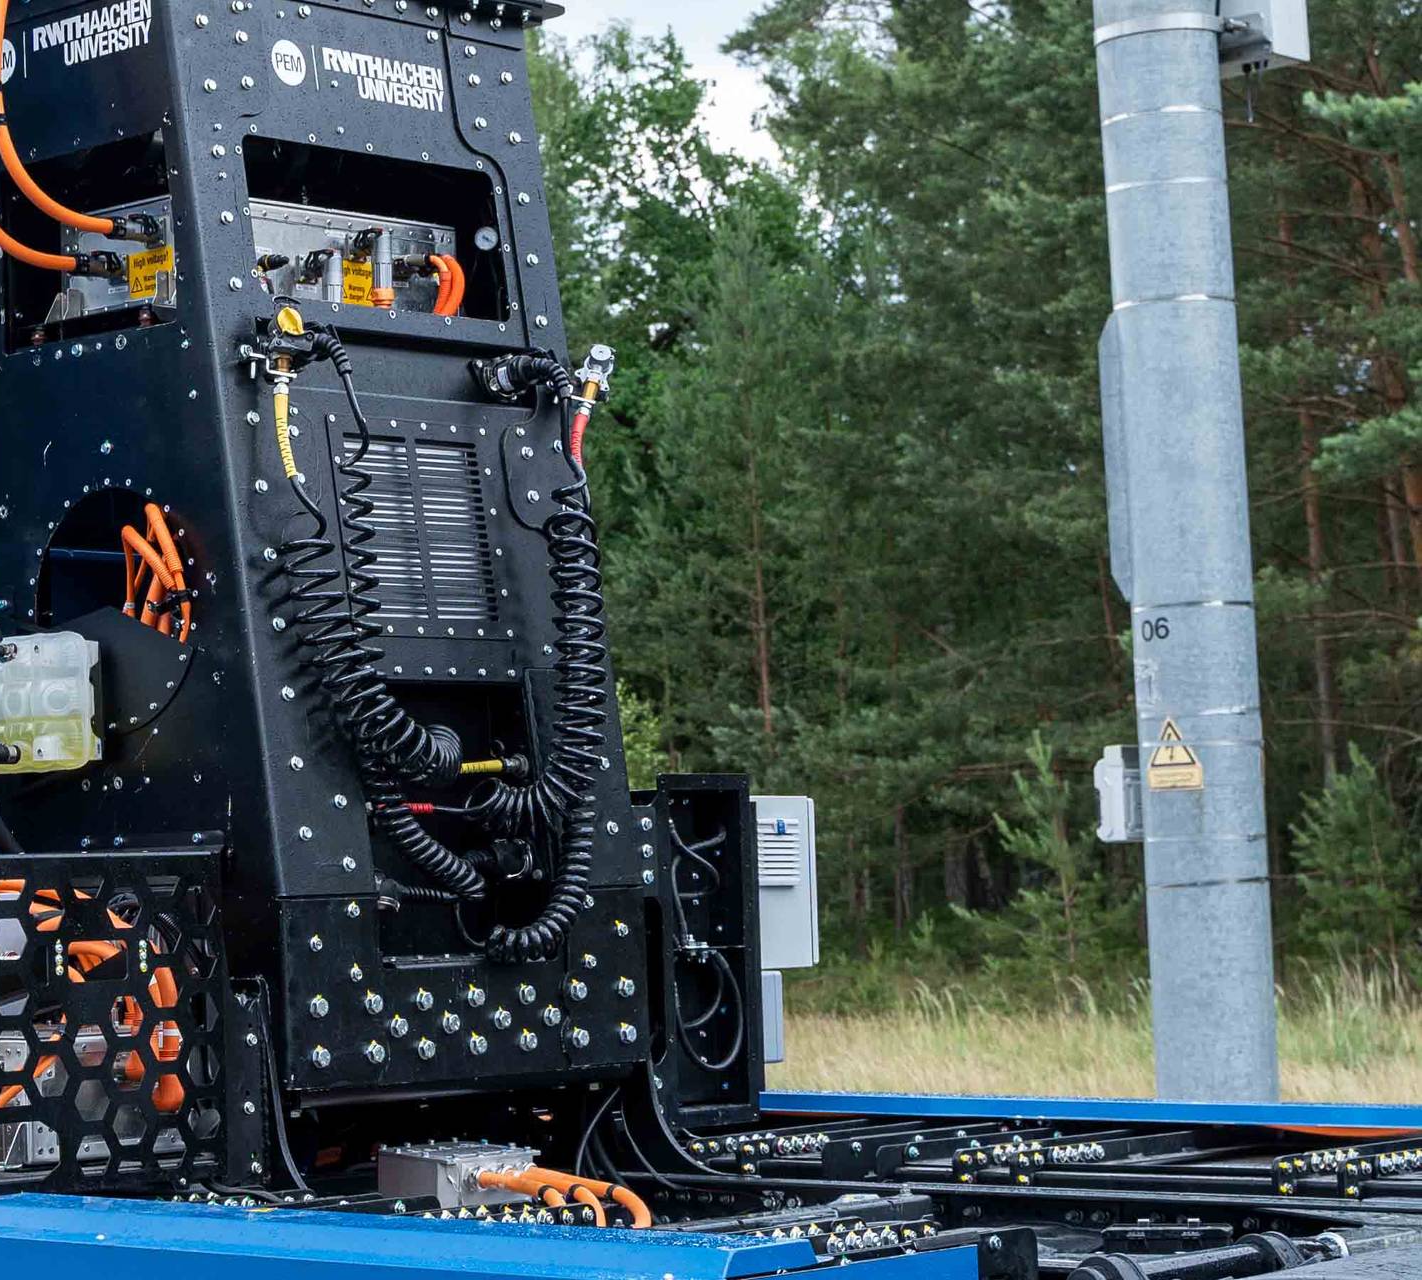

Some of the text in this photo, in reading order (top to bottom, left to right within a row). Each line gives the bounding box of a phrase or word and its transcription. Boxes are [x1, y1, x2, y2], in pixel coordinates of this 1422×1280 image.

[64, 19, 151, 66] UNIVERSITY
[275, 52, 302, 73] PEM
[357, 76, 444, 112] UNIVERSITY
[1142, 617, 1170, 642] 06
